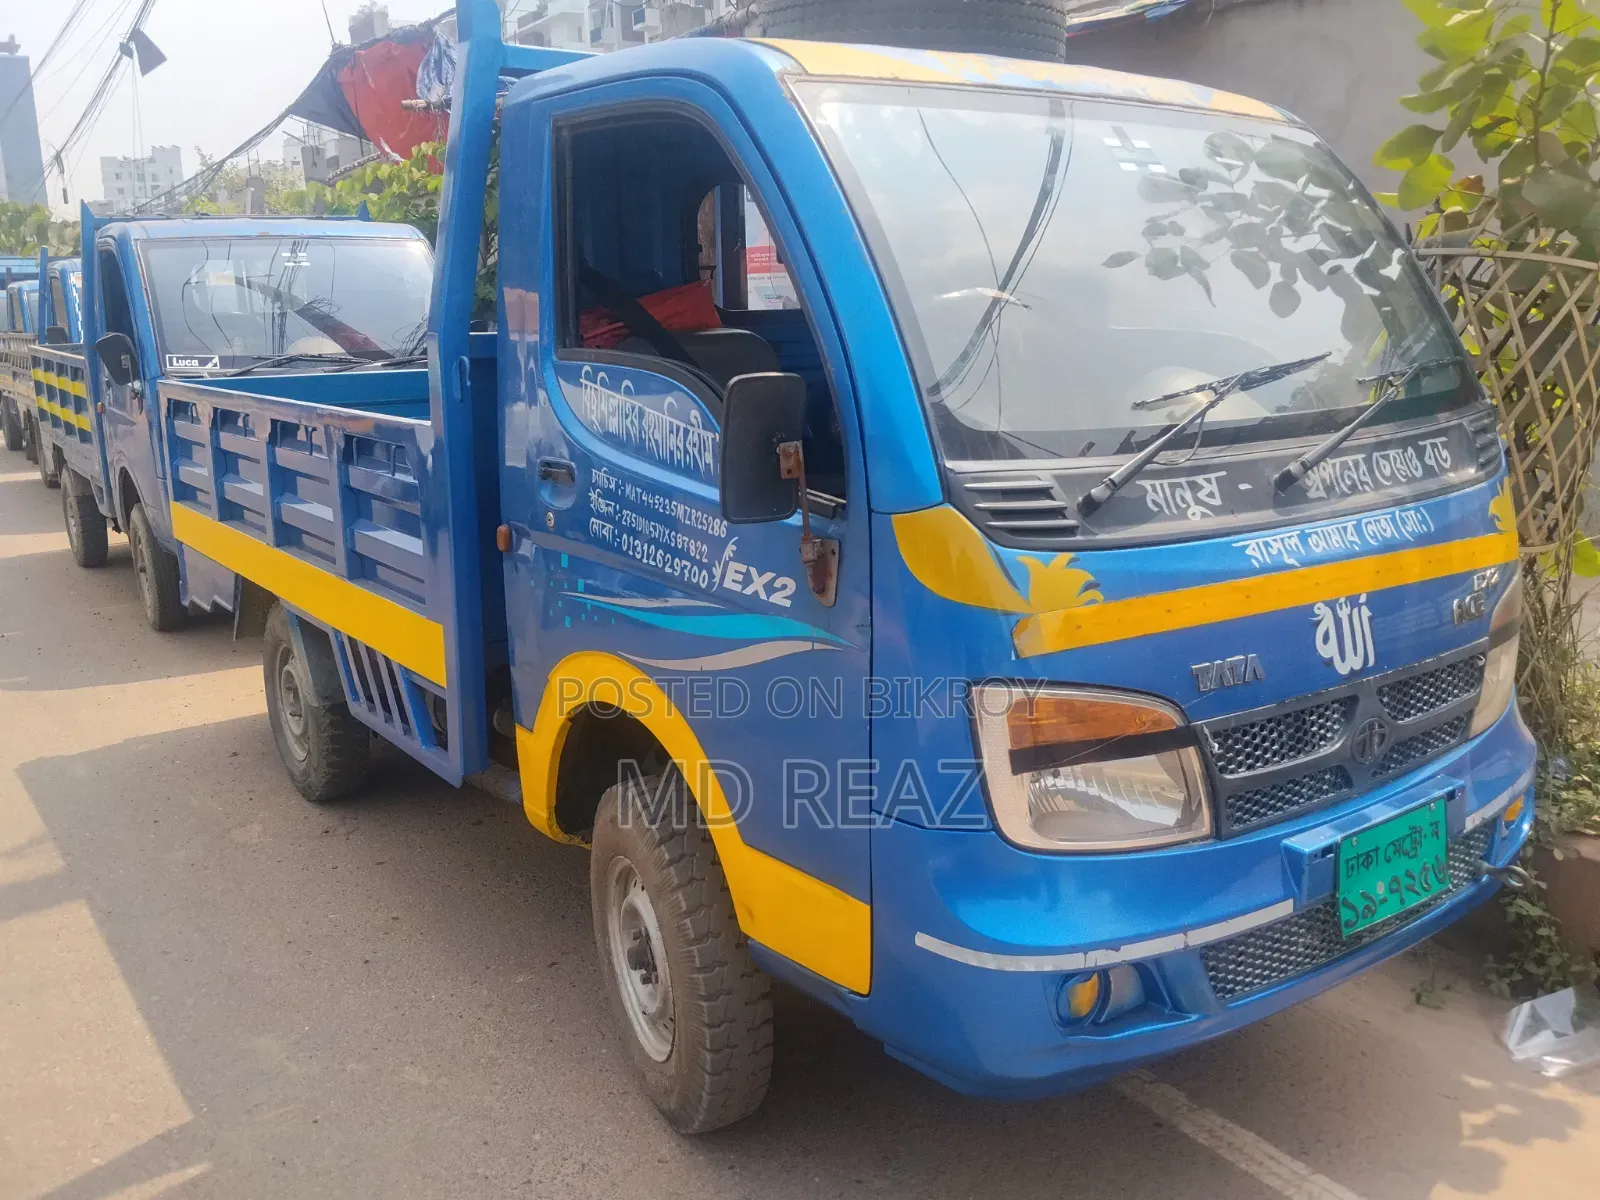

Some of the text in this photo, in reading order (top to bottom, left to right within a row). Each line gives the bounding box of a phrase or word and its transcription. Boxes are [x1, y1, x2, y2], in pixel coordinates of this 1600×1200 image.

[172, 357, 199, 367] Luca
[1136, 471, 1227, 520] মানুষ
[1305, 520, 1361, 551] আমার
[1361, 514, 1399, 546] নেতা
[621, 533, 708, 588] 01312629700
[723, 562, 797, 608] EX2
[1191, 653, 1266, 692] TATA
[1344, 845, 1380, 879] ঢাকা
